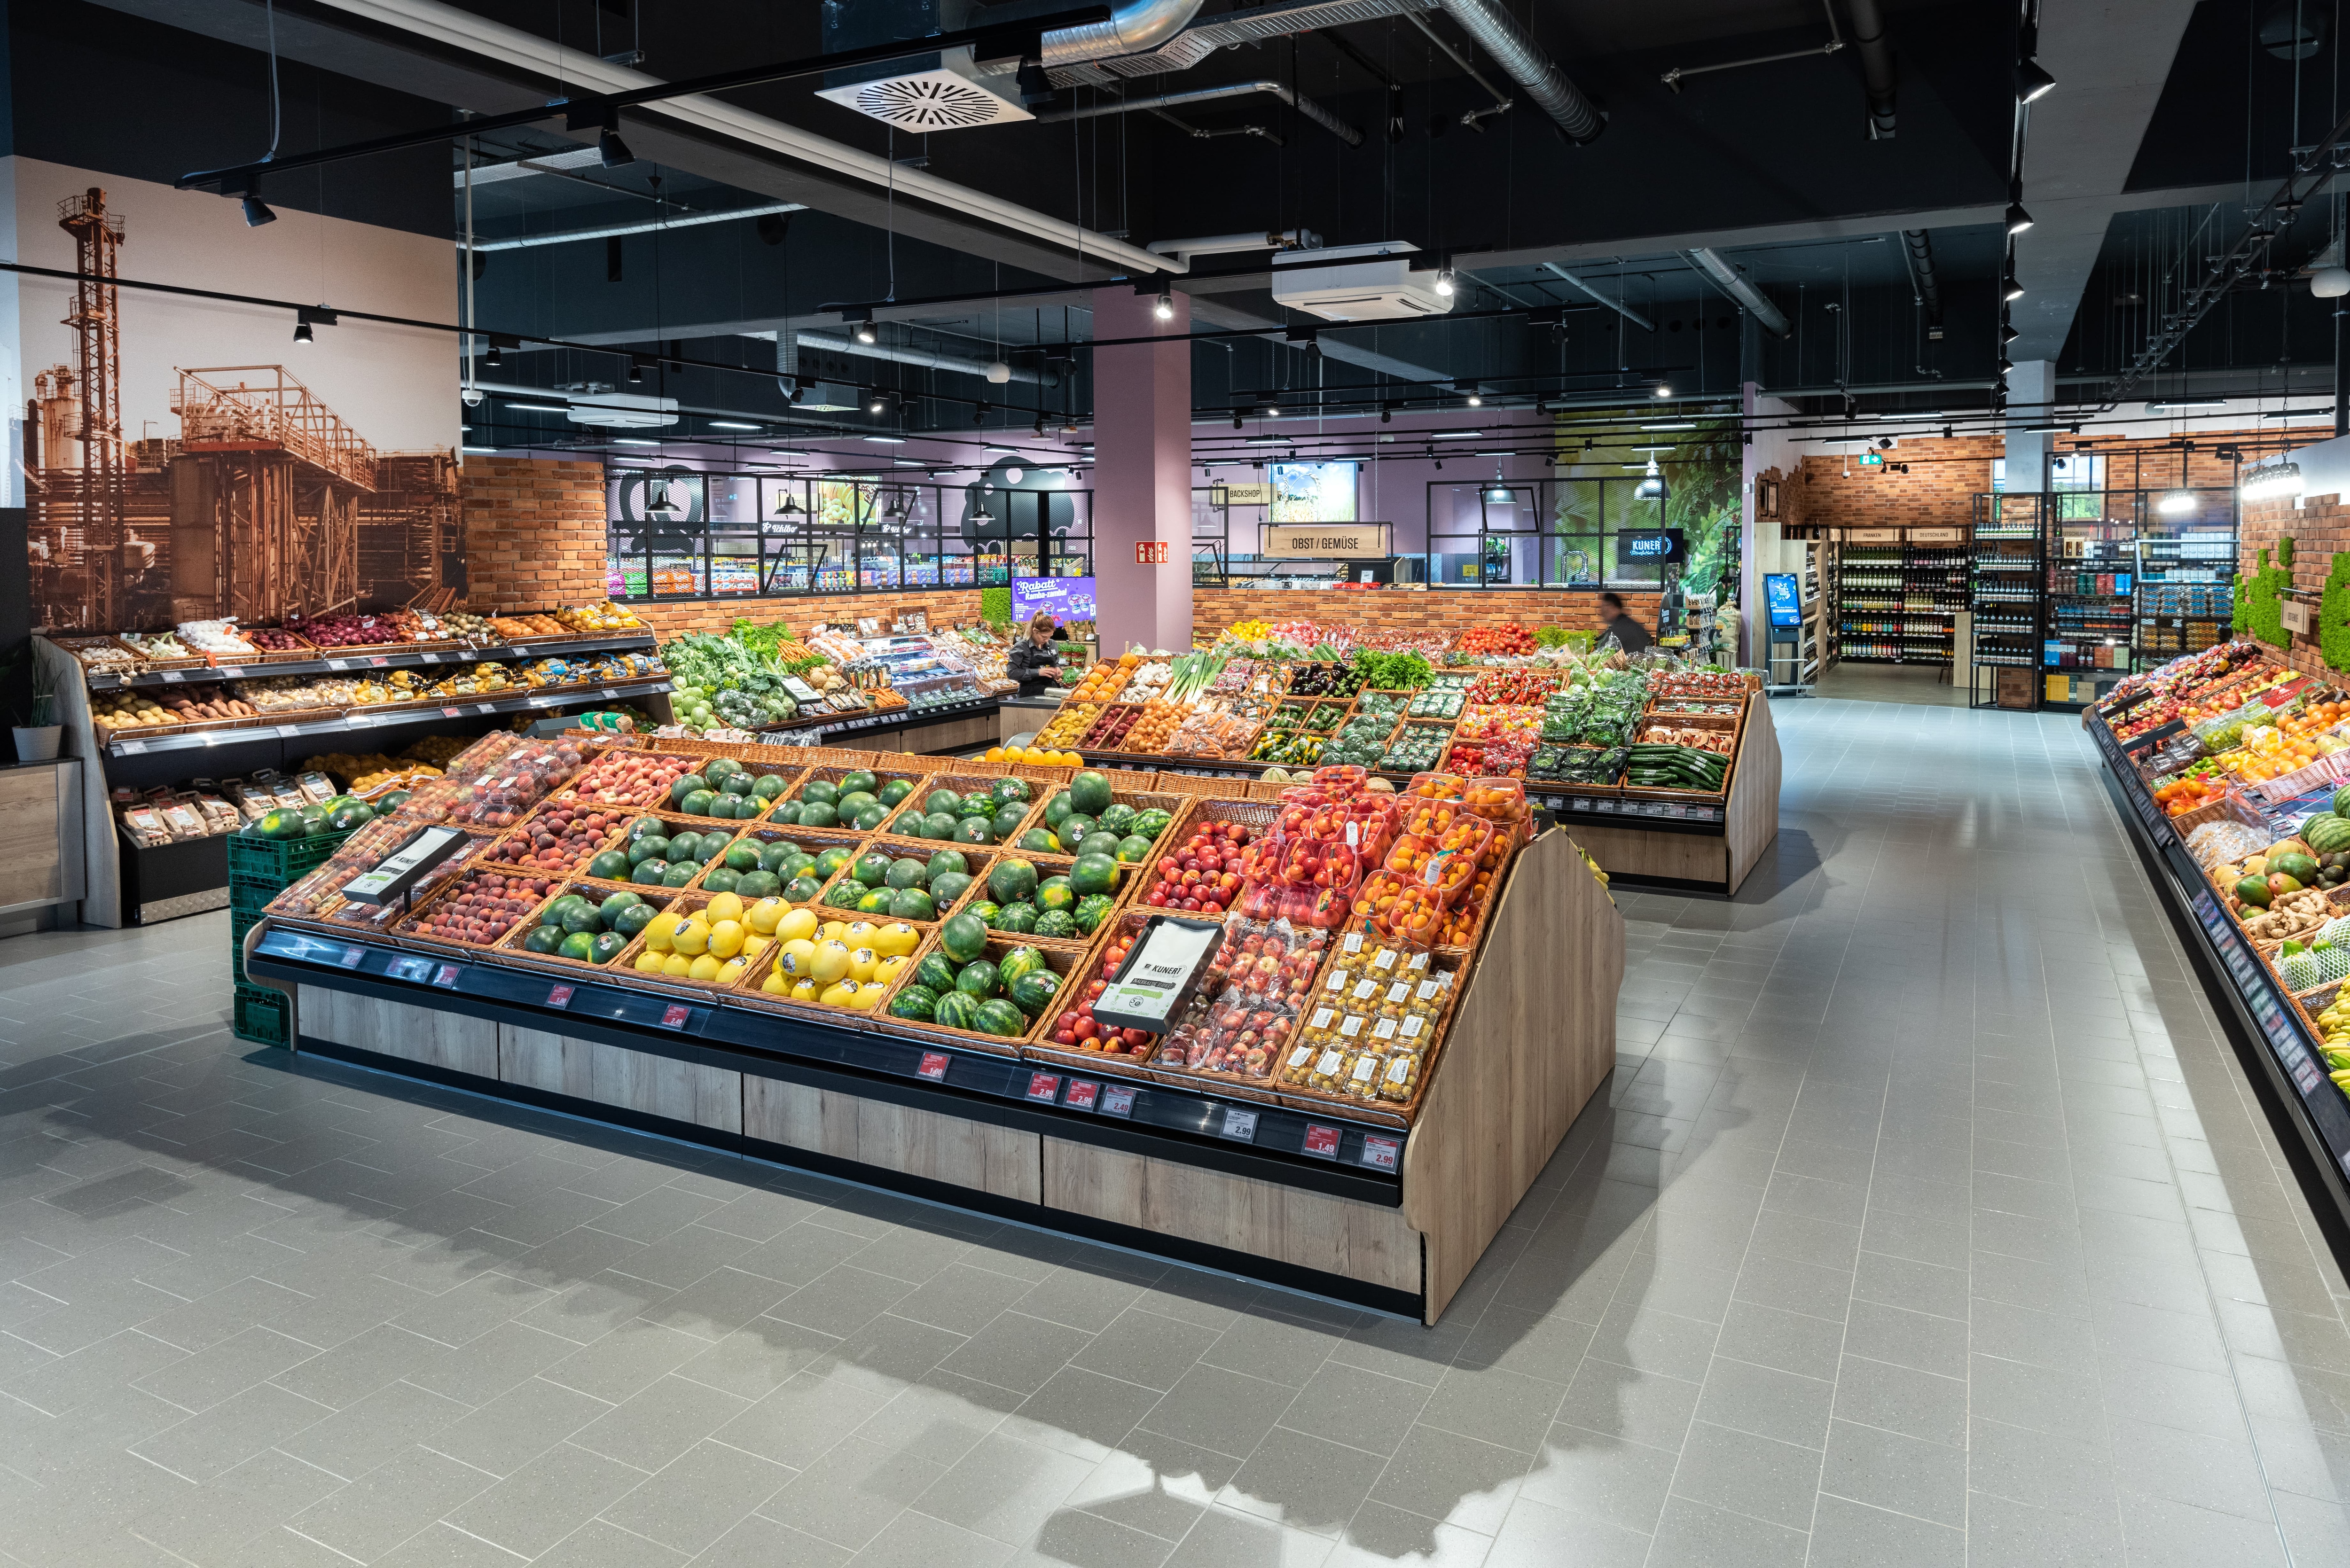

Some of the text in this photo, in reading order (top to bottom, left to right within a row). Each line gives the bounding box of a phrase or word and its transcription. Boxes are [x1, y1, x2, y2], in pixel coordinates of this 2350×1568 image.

[1292, 536, 1358, 549] OBST / GEMÜSE
[1020, 579, 1057, 593] Rabatt
[1025, 588, 1067, 601] Ramba-zamba!
[1152, 965, 1183, 975] KUNERT
[930, 1067, 942, 1076] 1.00
[1039, 1088, 1054, 1097] 2.99
[1077, 1096, 1092, 1104] 2.99
[1114, 1102, 1128, 1112] 2.49
[1235, 1126, 1251, 1136] 2.99
[1318, 1142, 1334, 1153] 1.49
[1376, 1154, 1393, 1164] 2.99
